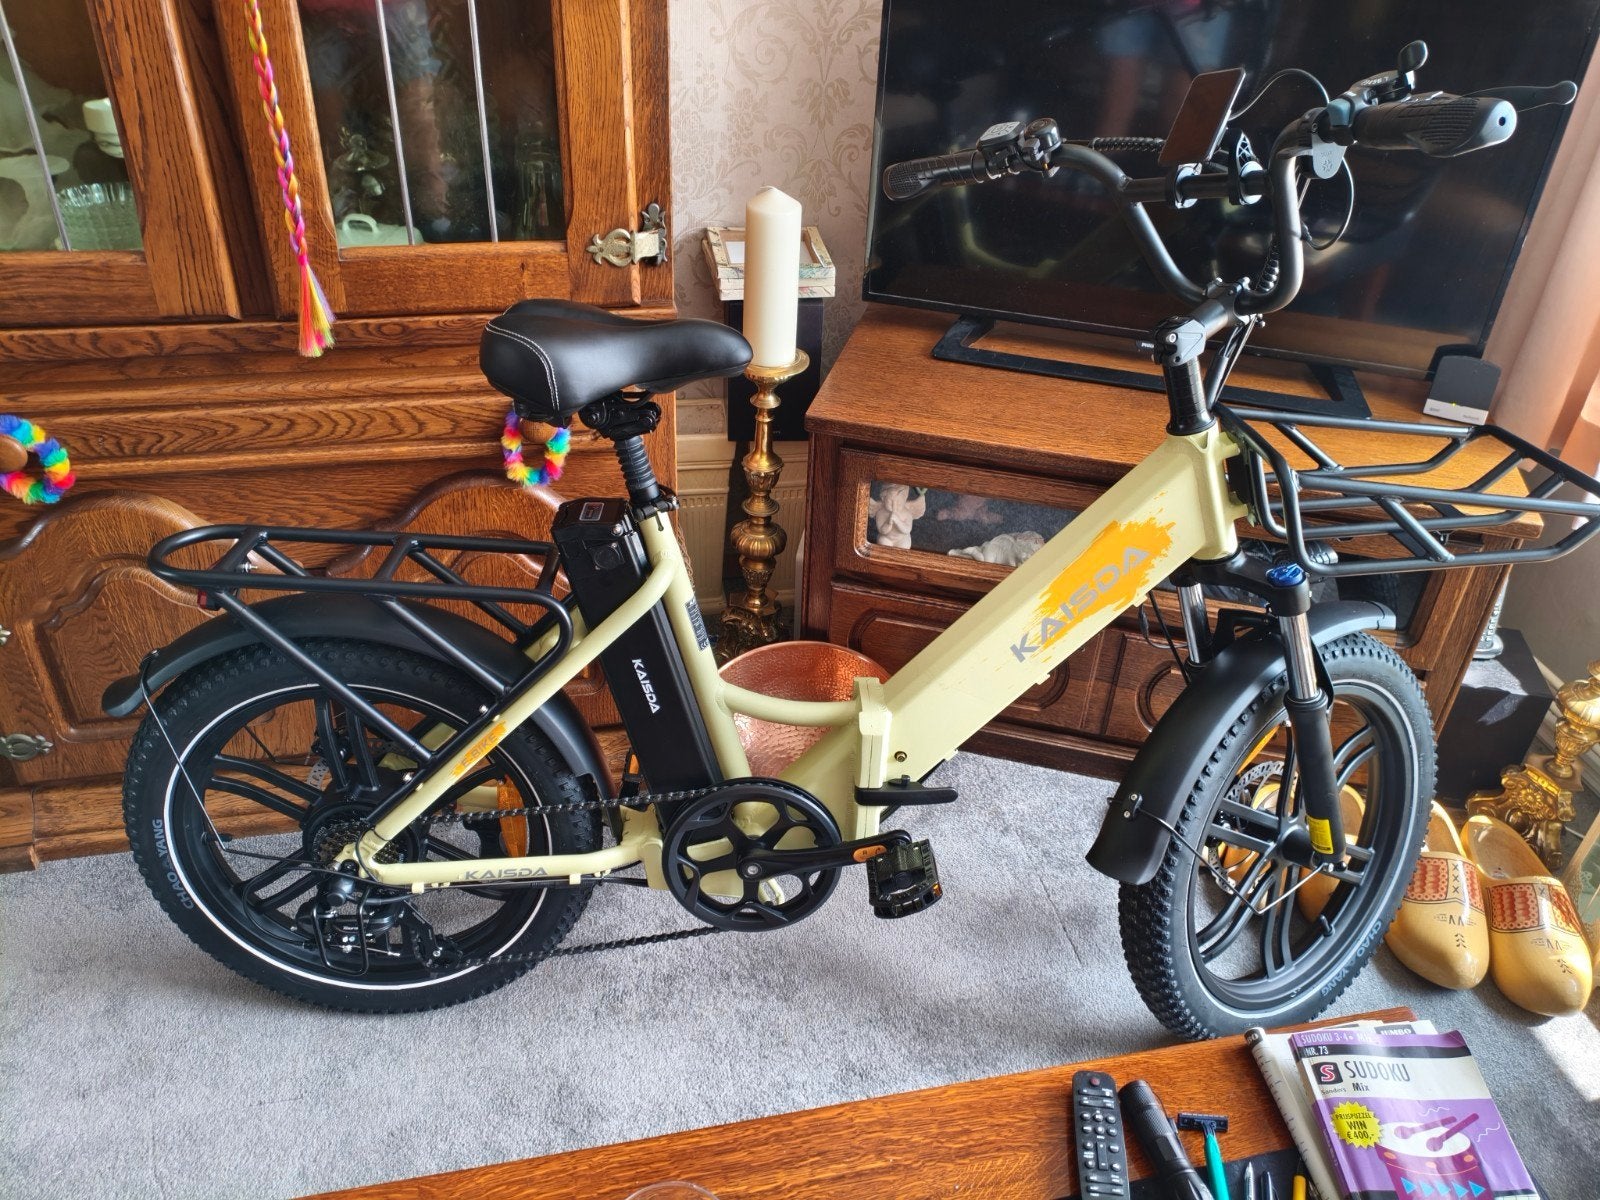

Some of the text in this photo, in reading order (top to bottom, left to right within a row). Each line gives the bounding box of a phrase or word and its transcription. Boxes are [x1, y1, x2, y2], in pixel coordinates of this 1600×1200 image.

[1010, 546, 1150, 663] KAISDA
[631, 658, 661, 714] KAISDA
[152, 819, 194, 909] CHAO YANG
[465, 867, 548, 880] KAISDA
[1321, 967, 1349, 996] YANG
[1301, 1032, 1333, 1045] SUDOKU
[1319, 1045, 1329, 1055] 73
[1319, 1064, 1336, 1082] S
[1344, 1060, 1411, 1082] SUDOKU
[1352, 1082, 1370, 1092] Mix
[1346, 1120, 1368, 1131] WIN
